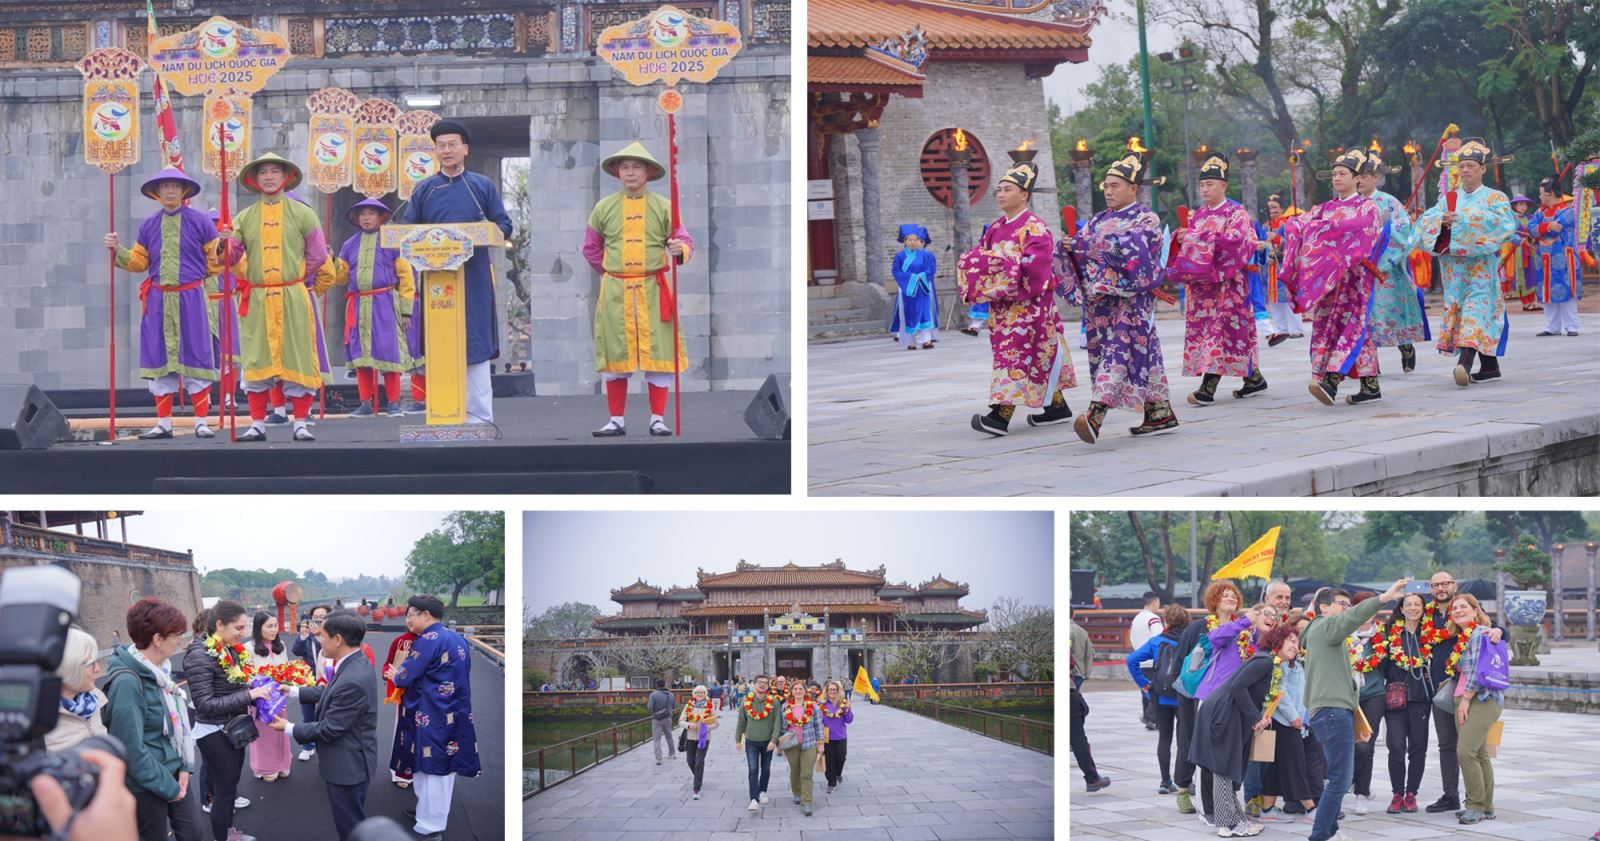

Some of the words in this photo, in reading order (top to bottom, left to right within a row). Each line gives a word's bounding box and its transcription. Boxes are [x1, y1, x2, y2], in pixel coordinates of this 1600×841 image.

[638, 51, 652, 60] DU
[711, 47, 728, 57] GIA
[187, 62, 202, 71] DU
[259, 58, 277, 67] GIA
[671, 60, 704, 72] 2025
[219, 71, 253, 83] 2025
